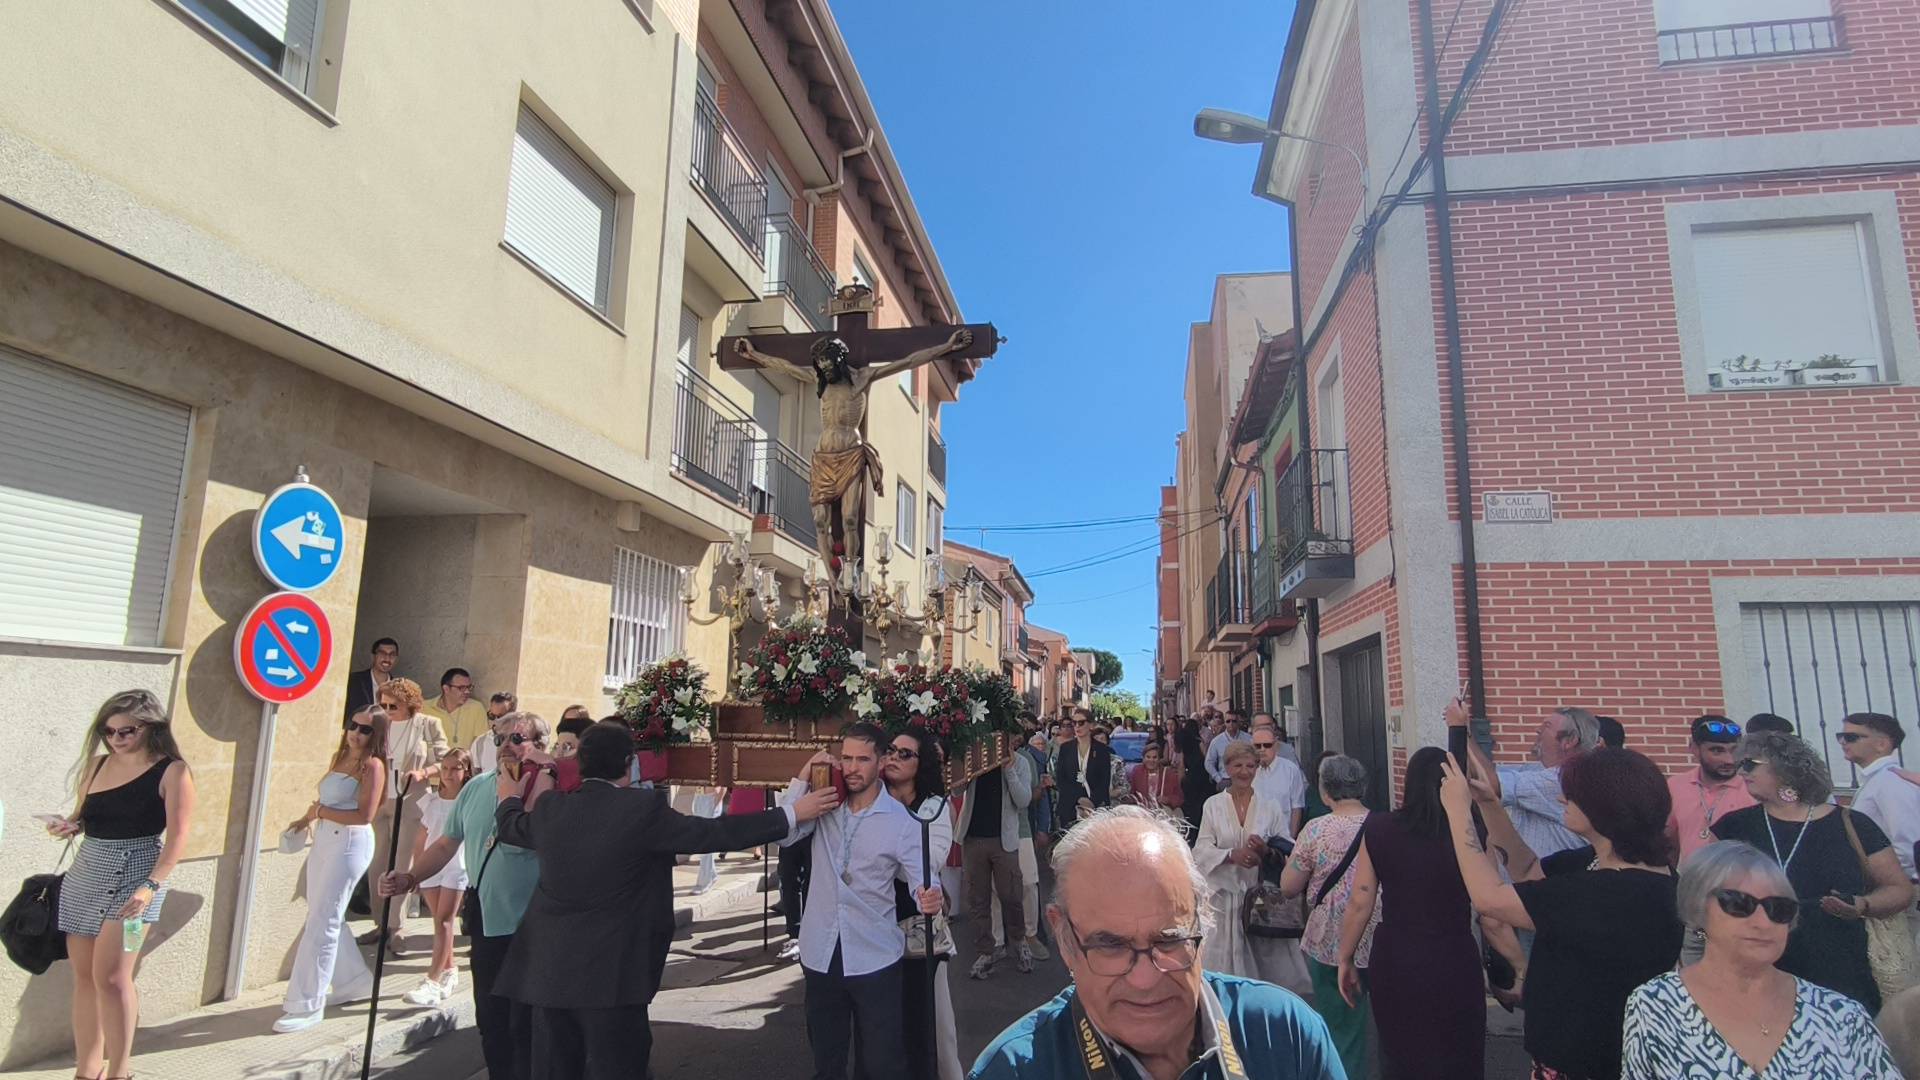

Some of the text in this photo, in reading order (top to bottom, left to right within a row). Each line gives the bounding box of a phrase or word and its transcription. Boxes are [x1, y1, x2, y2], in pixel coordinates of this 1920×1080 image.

[1489, 507, 1510, 519] ISABEL
[1511, 507, 1519, 519] LA
[1505, 497, 1532, 505] CALLE
[1079, 1018, 1106, 1071] Nikon
[1217, 1019, 1243, 1076] Nikon
